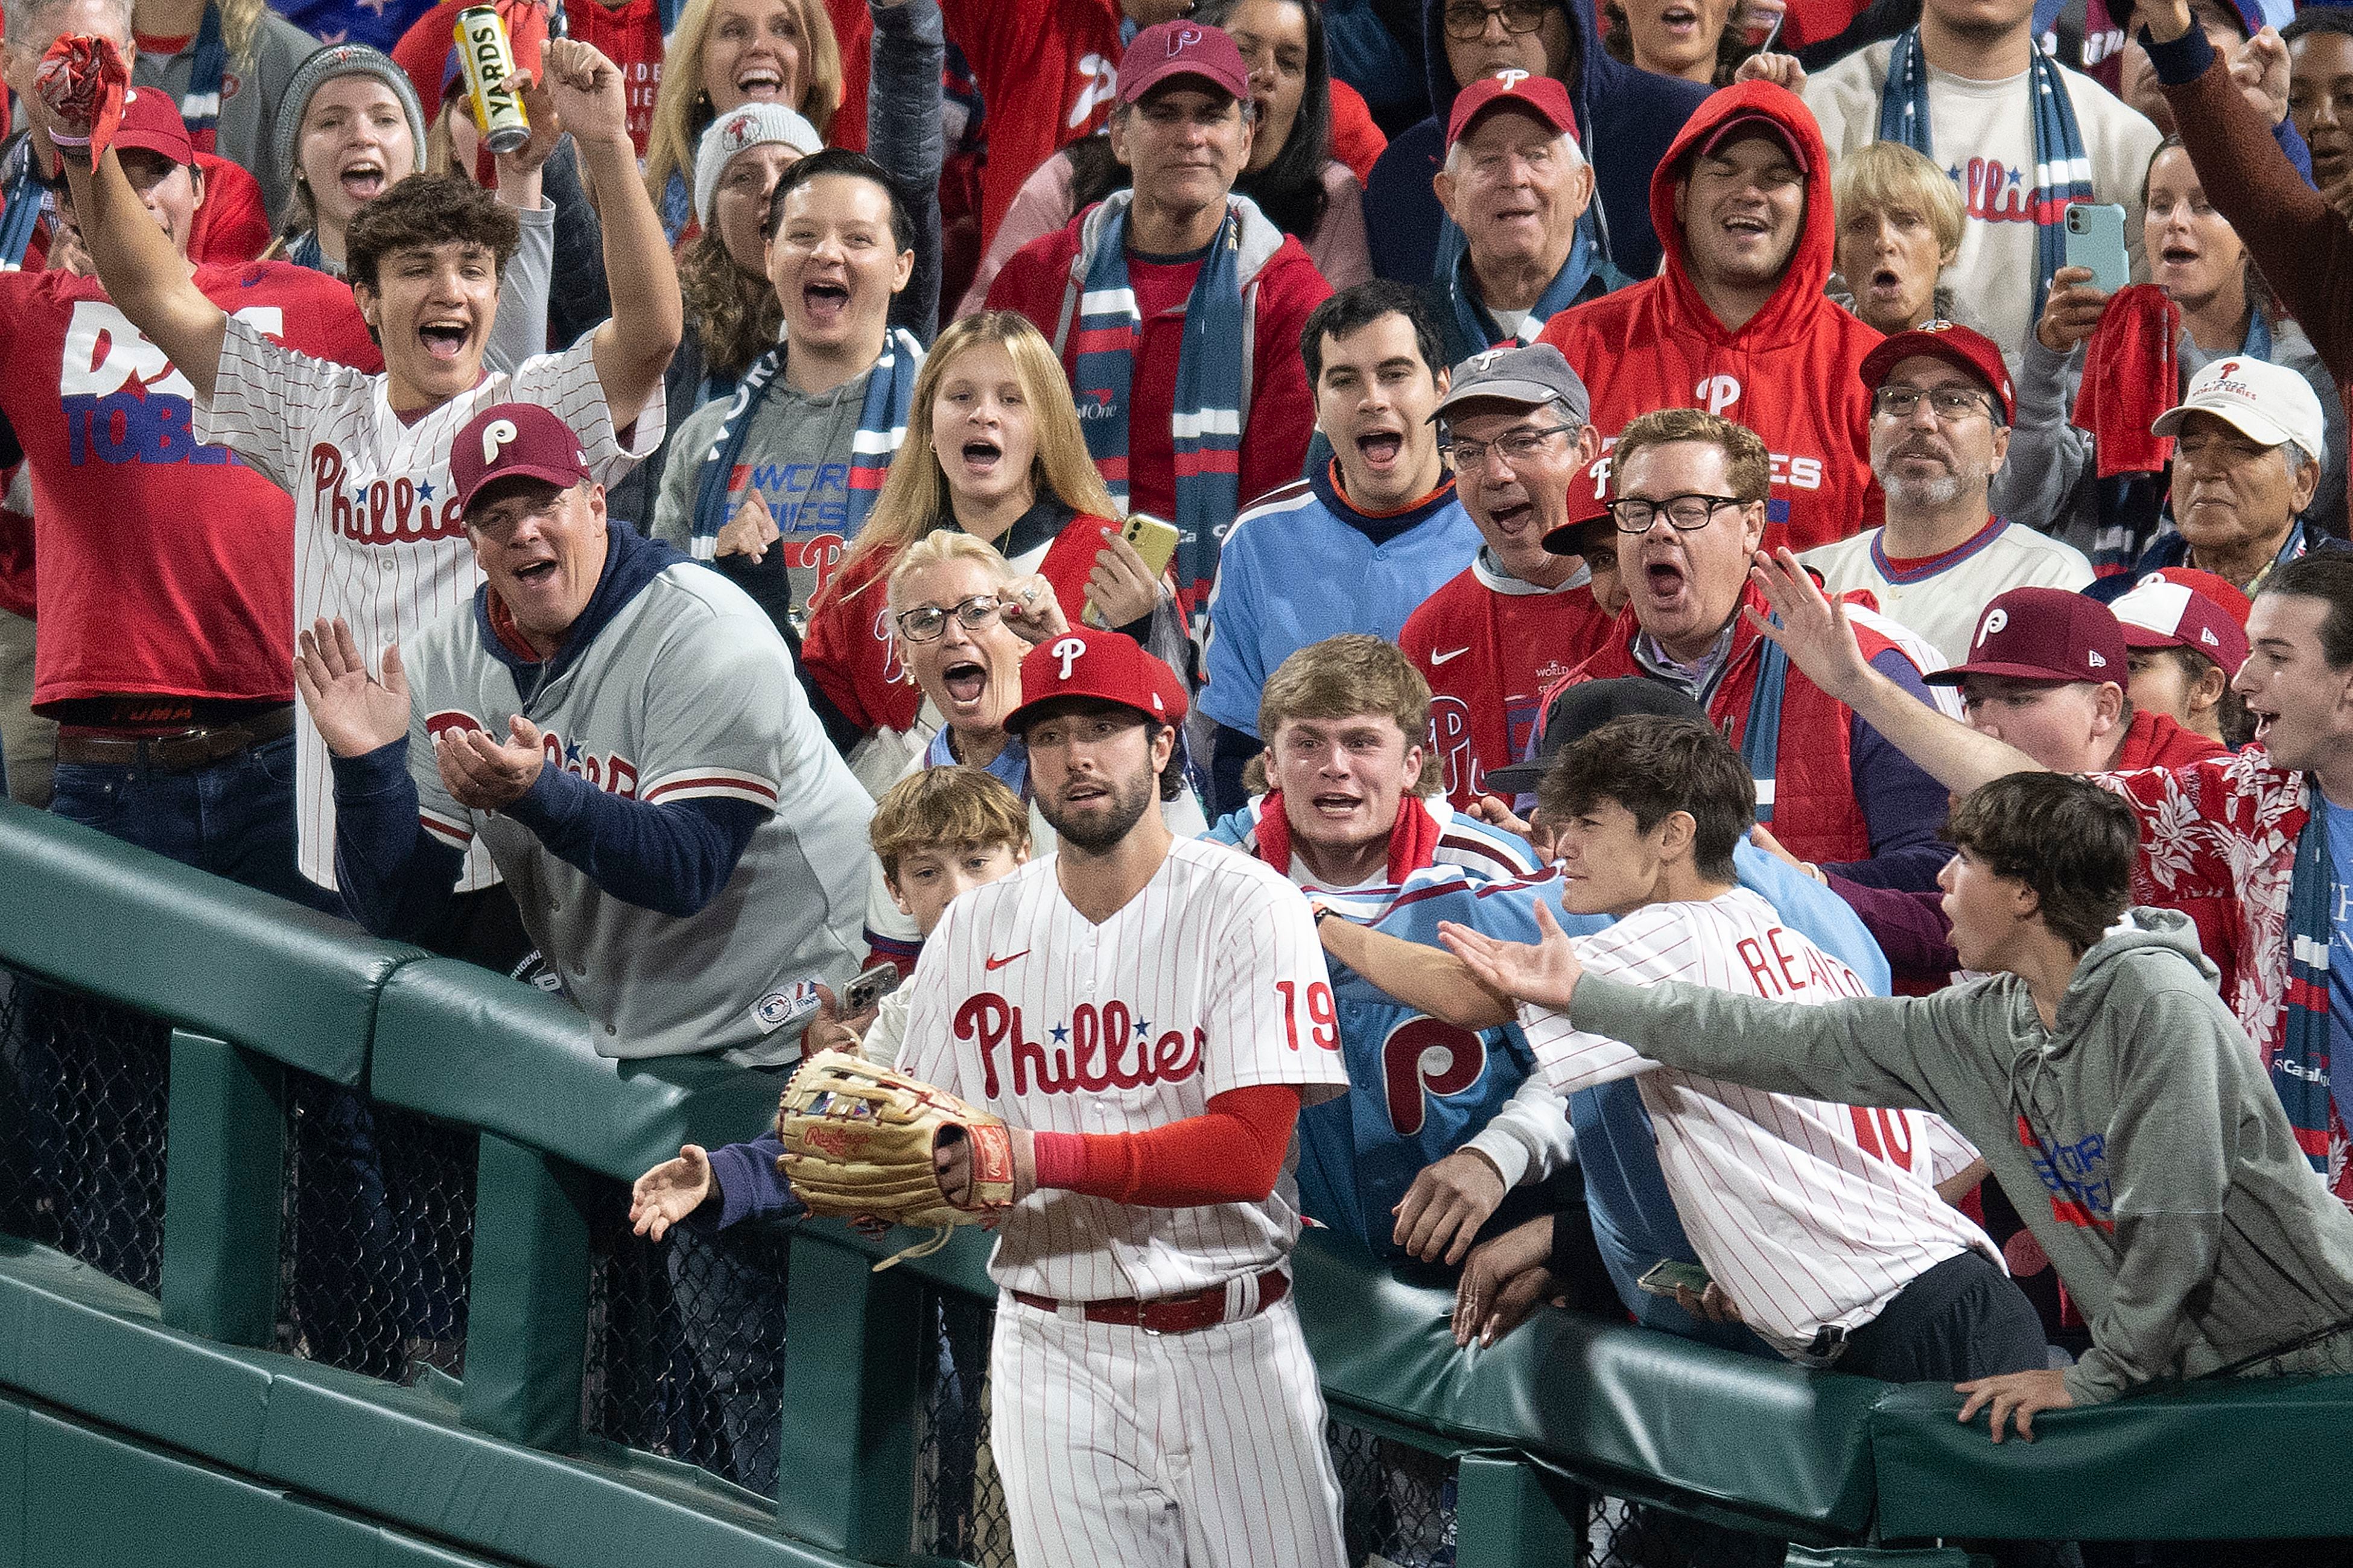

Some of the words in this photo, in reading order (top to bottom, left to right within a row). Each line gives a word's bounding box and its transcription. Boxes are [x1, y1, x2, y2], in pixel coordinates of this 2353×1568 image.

[472, 27, 512, 118] YARDS
[1051, 638, 1087, 680] P
[1535, 666, 1569, 677] WORLD
[1275, 980, 1340, 1052] 19
